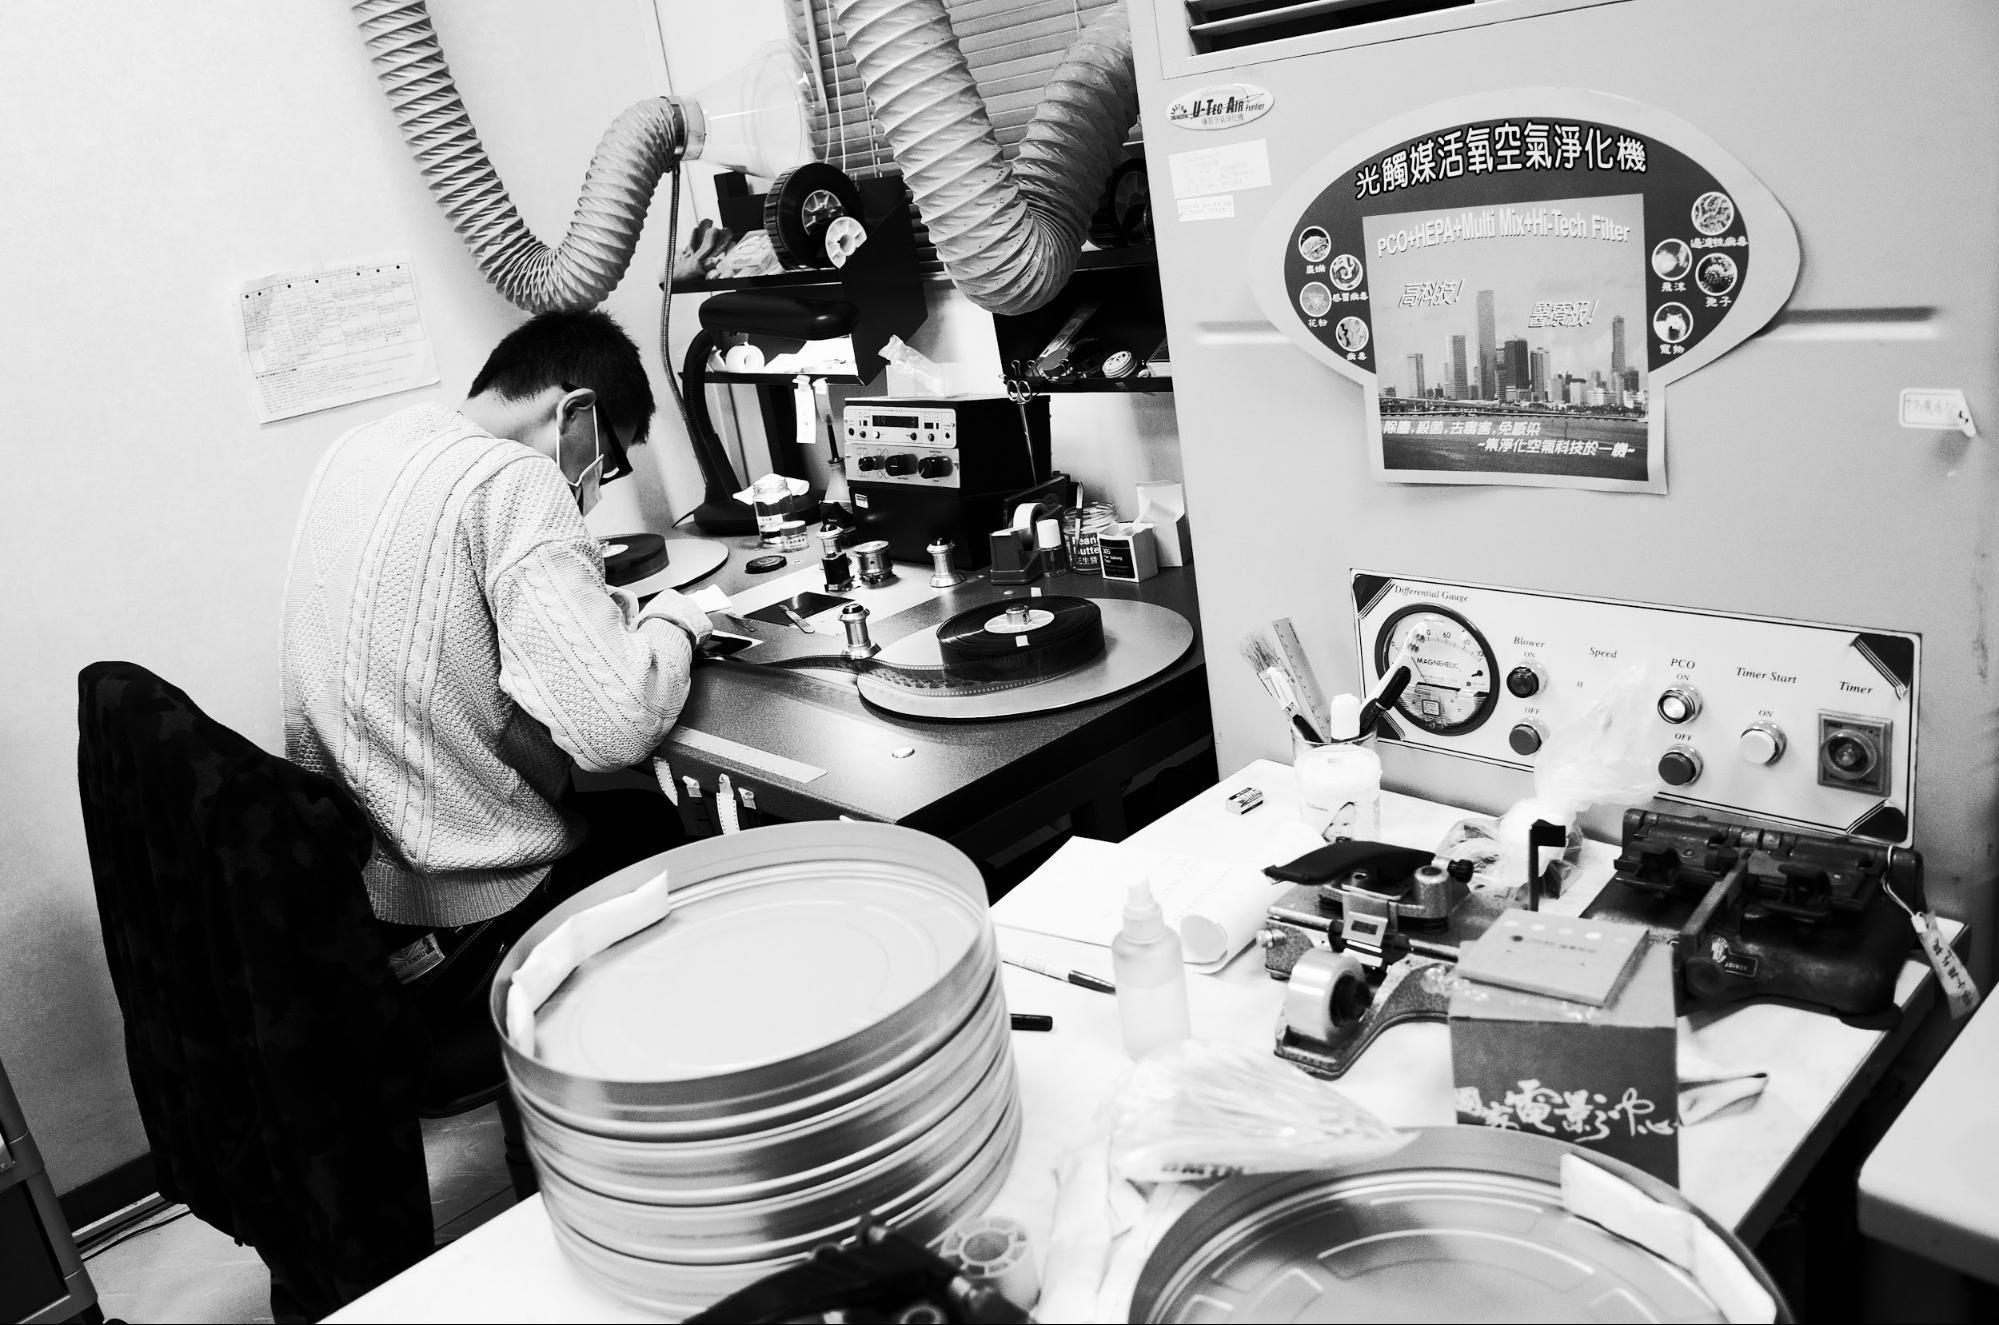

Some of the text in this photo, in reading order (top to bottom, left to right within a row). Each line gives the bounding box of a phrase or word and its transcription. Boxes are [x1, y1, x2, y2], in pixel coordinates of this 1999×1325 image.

[1354, 121, 1648, 200] 光觸媒活氧空氣淨化機
[1377, 208, 1631, 258] PCO+HEPA+Multi Mix+Hi-Tech Filter
[1308, 318, 1328, 328] 花粉
[1394, 585, 1469, 602] Differential Gauge
[1513, 636, 1545, 648] Blower
[1588, 646, 1618, 659] Speed
[1416, 657, 1459, 669] MAGNEHELIC
[1670, 657, 1696, 670] PCO
[1676, 673, 1690, 682] ON
[1736, 666, 1797, 684] Timer Start
[1839, 680, 1874, 695] Timer
[1524, 706, 1541, 715] OFF
[1758, 709, 1774, 718] ON
[1674, 732, 1694, 742] OFF
